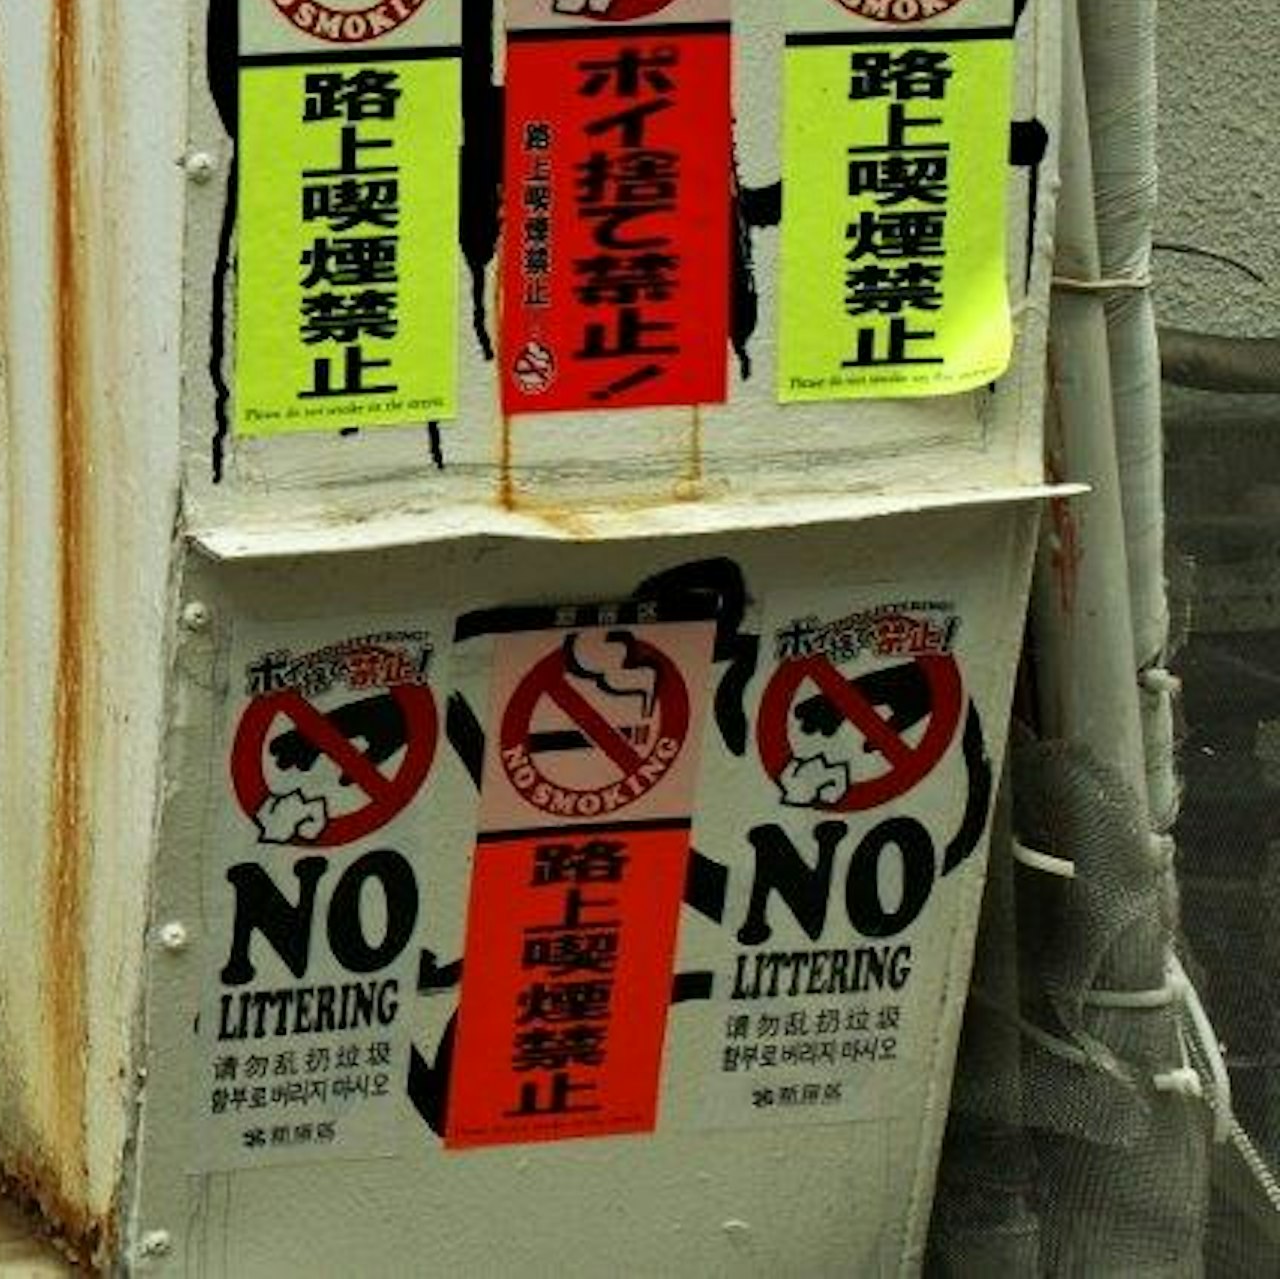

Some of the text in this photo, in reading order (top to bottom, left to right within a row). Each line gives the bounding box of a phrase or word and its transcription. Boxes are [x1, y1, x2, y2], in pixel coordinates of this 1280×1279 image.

[296, 68, 404, 399] 路上喫煙禁止
[842, 48, 954, 368] 路上喫煙禁止
[501, 736, 679, 816] NO SMOKING
[220, 848, 419, 986] NO
[736, 816, 936, 946] NO
[218, 978, 398, 1041] LITTERING
[500, 840, 631, 1119] 路上喫煙禁止
[730, 945, 912, 1000] LITTERING
